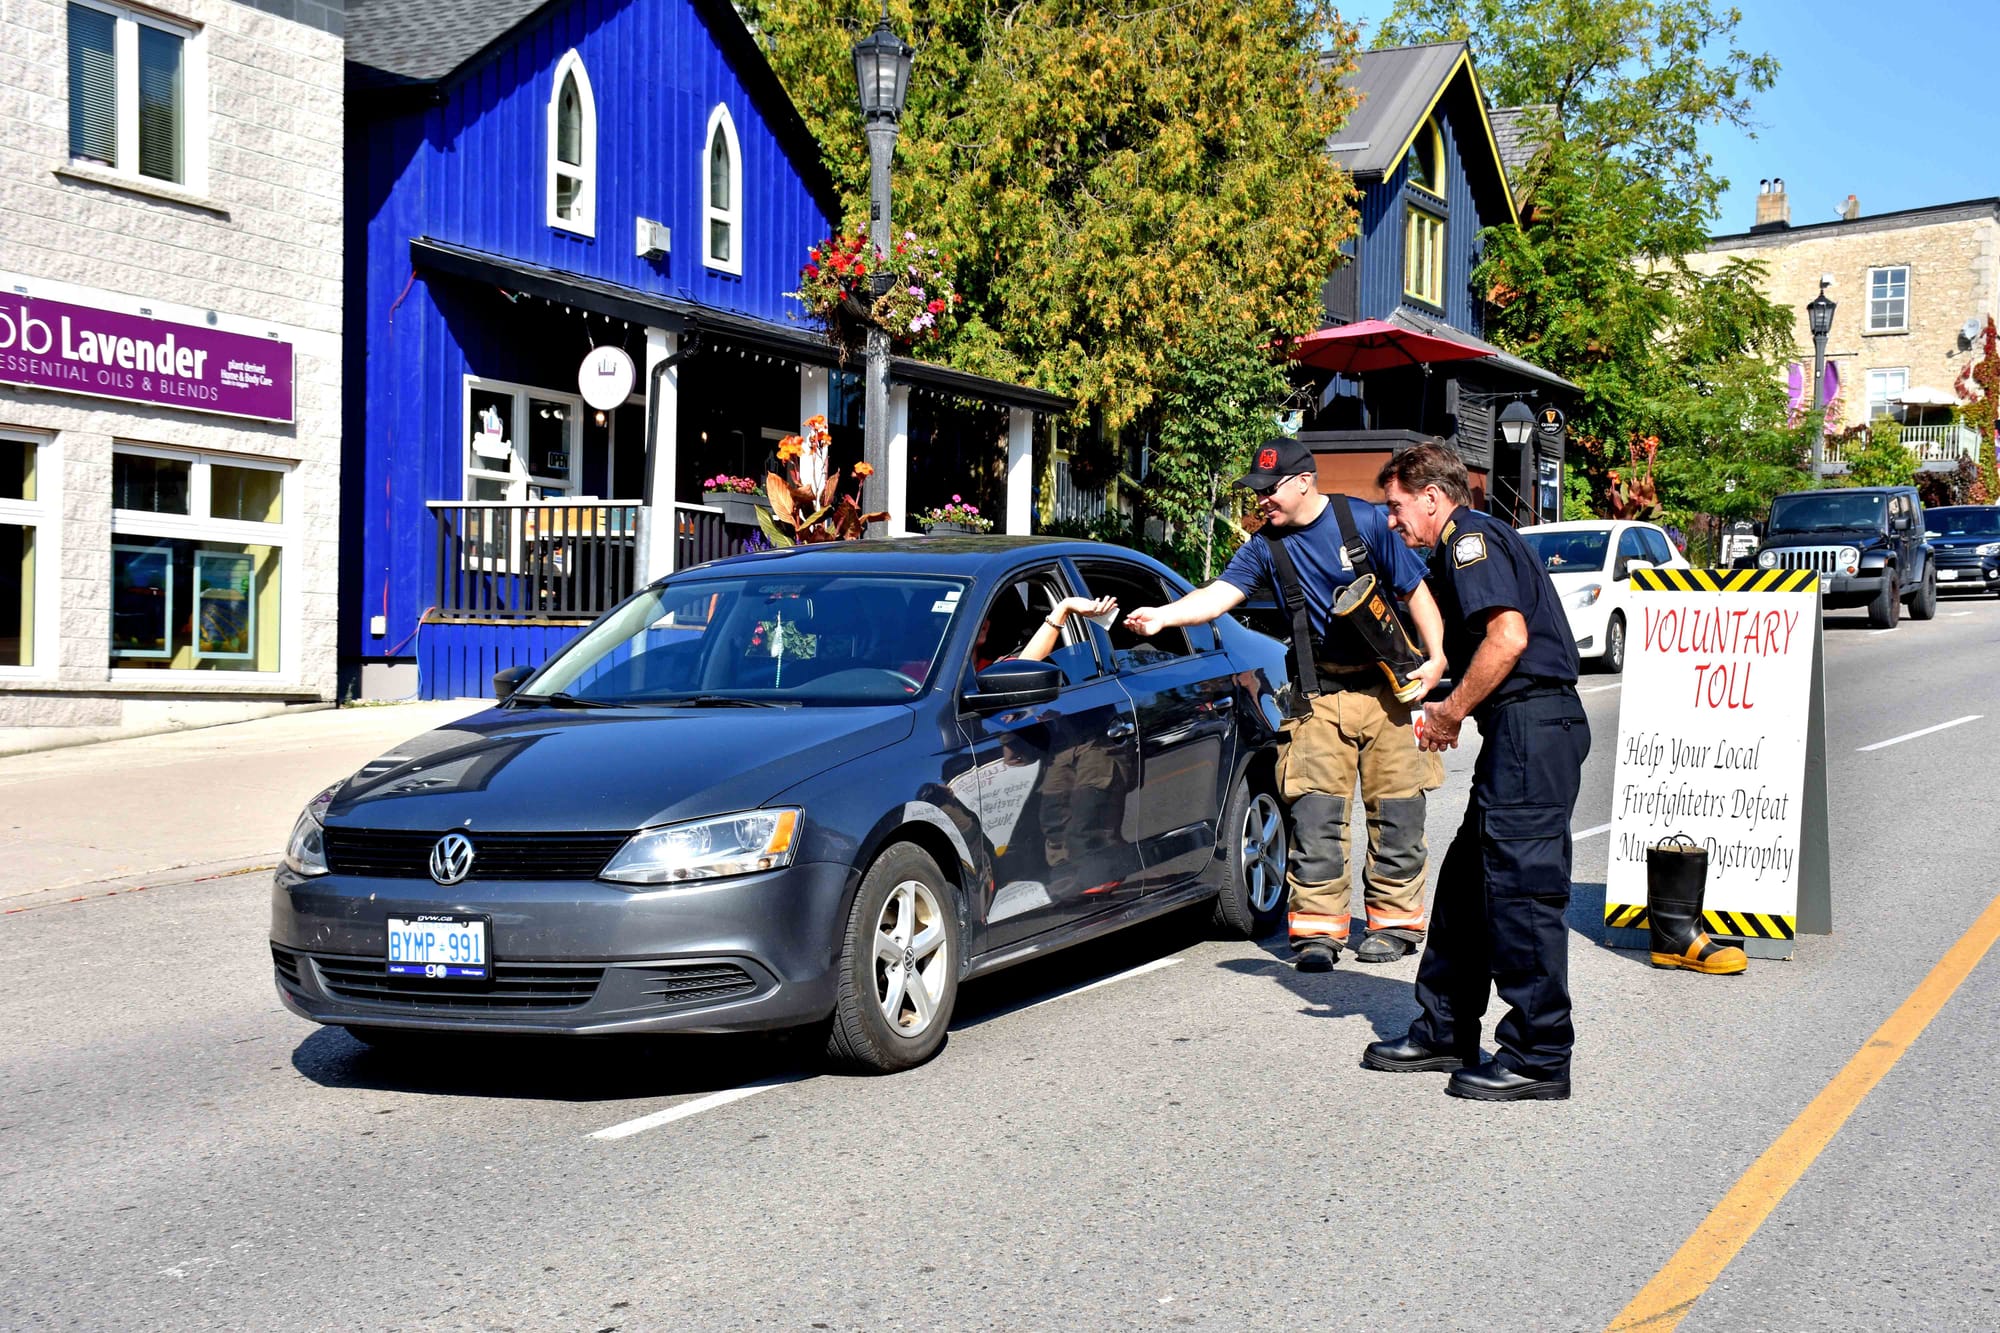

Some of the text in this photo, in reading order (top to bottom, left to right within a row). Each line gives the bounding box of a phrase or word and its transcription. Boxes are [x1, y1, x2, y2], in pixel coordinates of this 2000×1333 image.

[61, 315, 208, 380] Lavender
[97, 370, 134, 389] OILS
[142, 377, 152, 391] &
[160, 379, 218, 401] BLENDS
[1644, 606, 1799, 657] VOLUNTARY
[1694, 661, 1754, 709] TOLL
[1623, 732, 1765, 778] Help Your Local
[1618, 780, 1789, 831] Firefightetrs Defeat
[1702, 835, 1794, 883] Dystrophy
